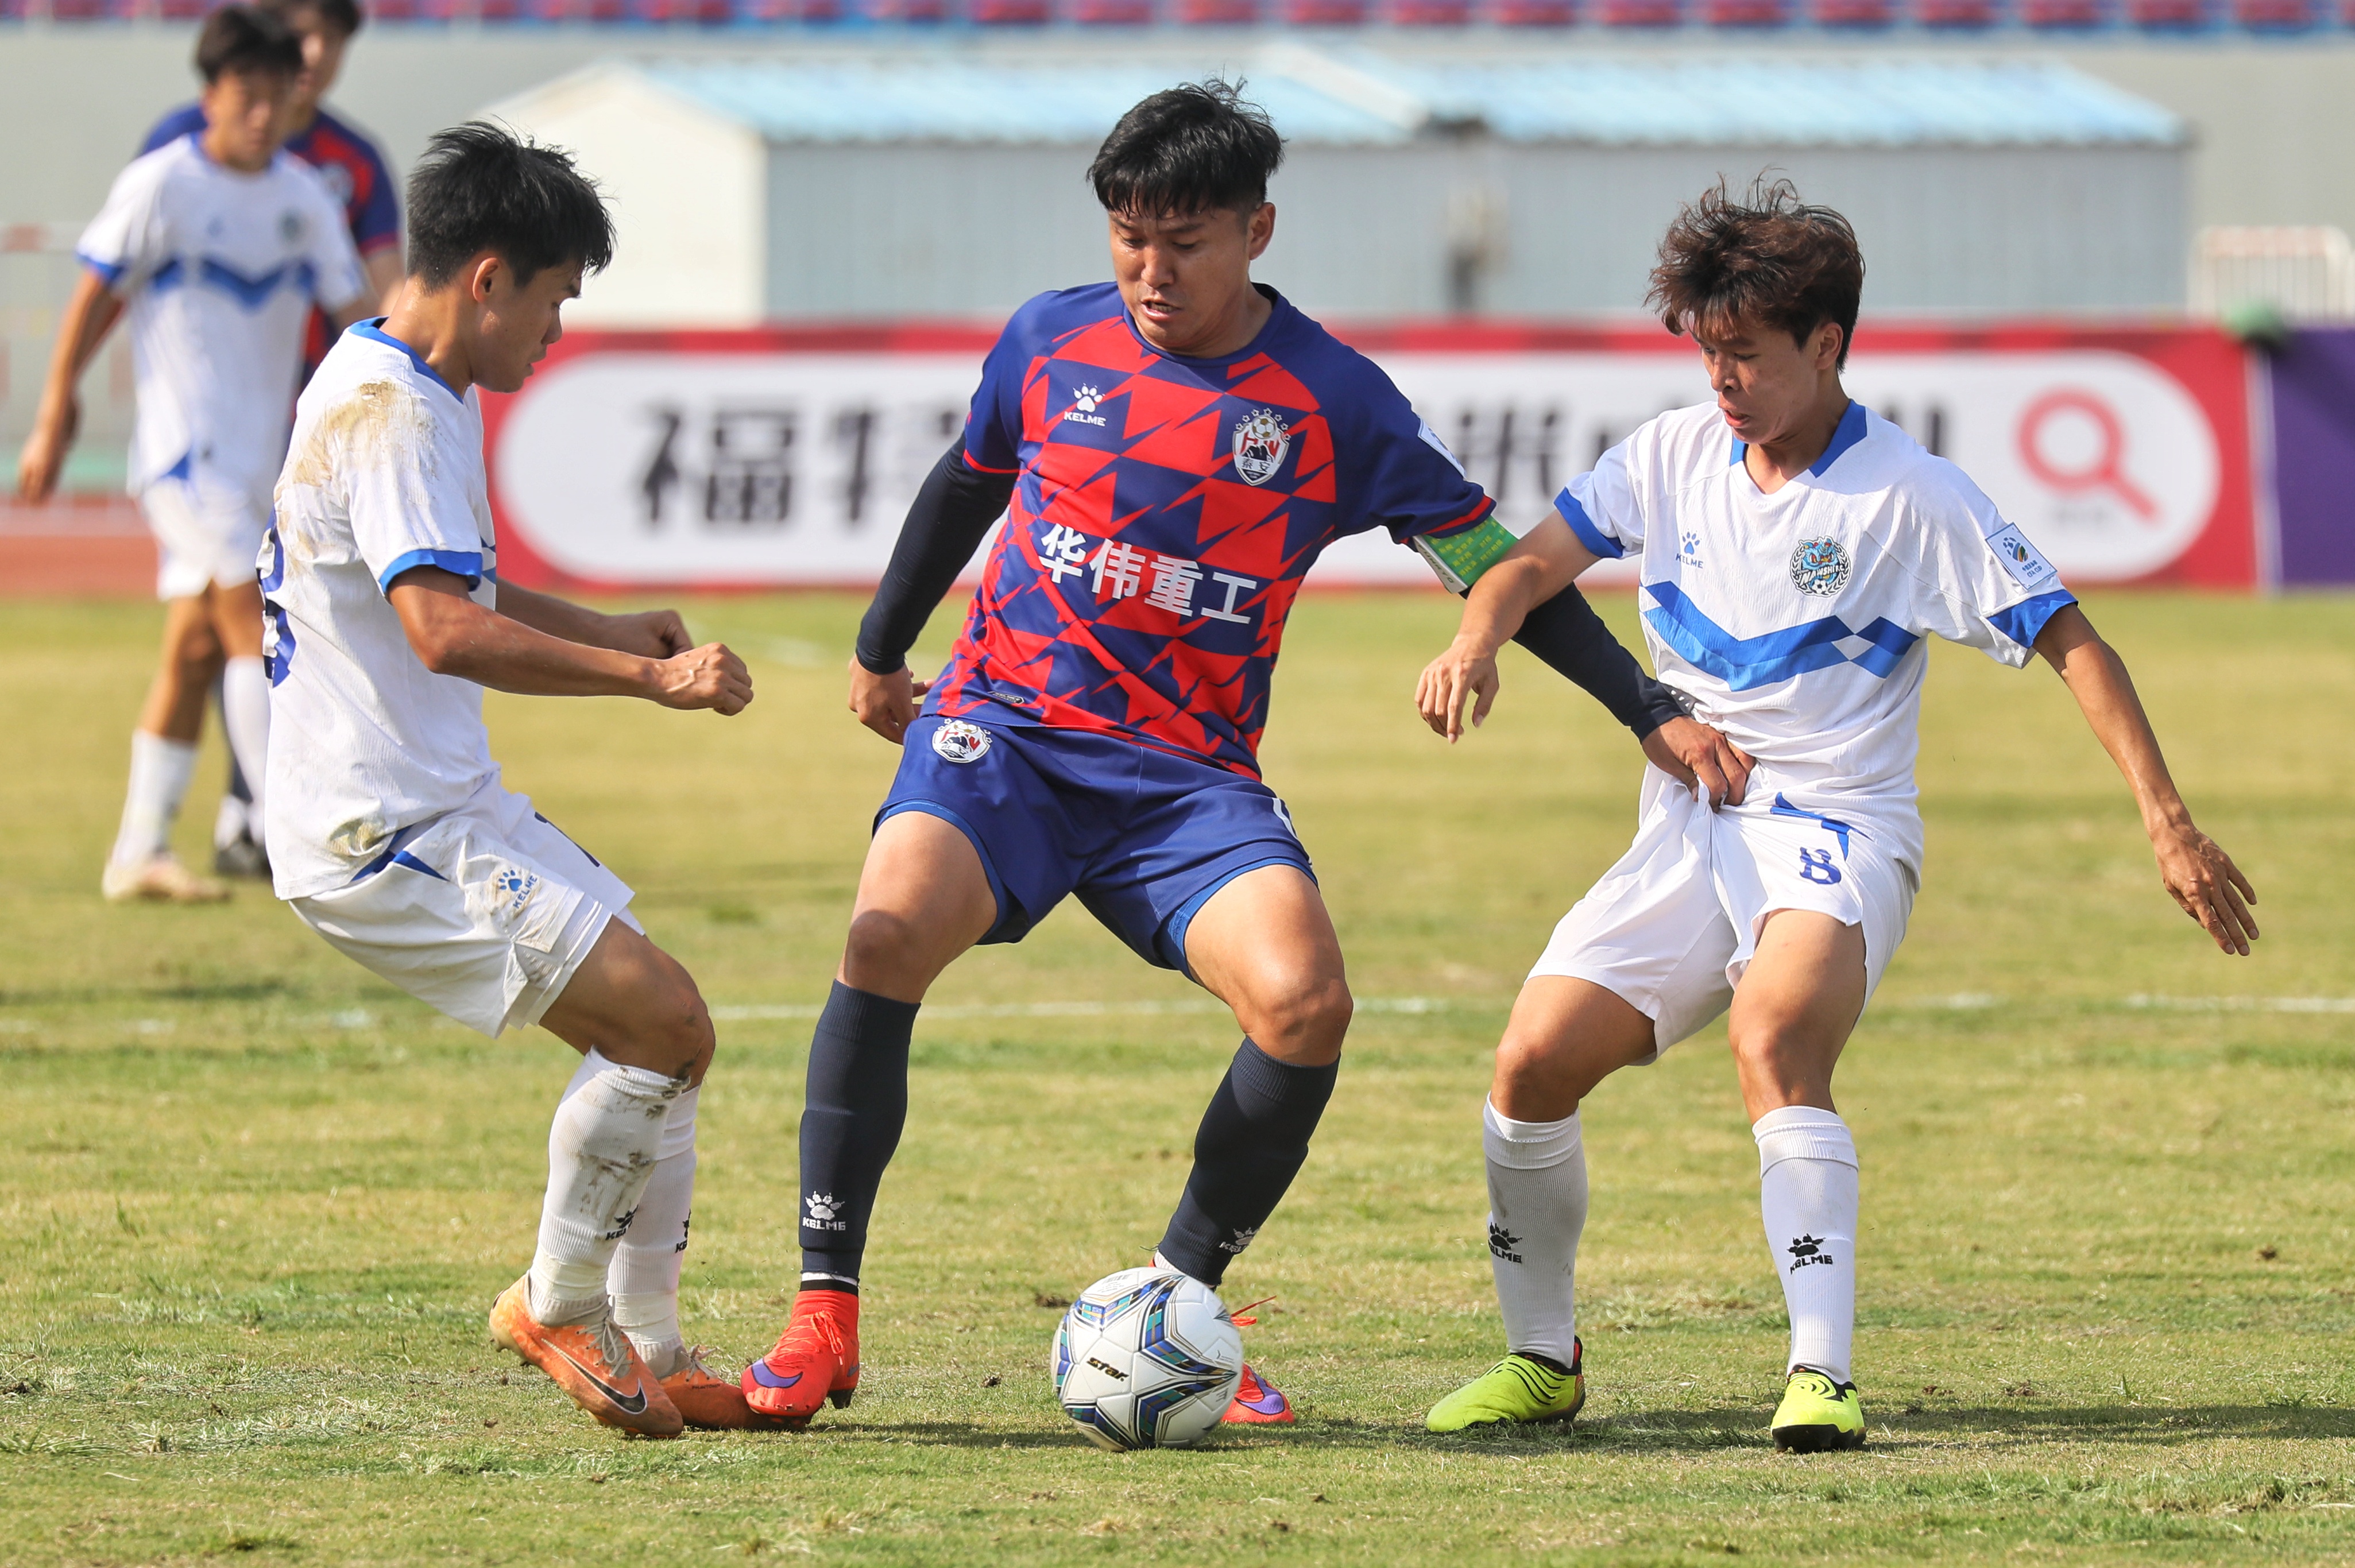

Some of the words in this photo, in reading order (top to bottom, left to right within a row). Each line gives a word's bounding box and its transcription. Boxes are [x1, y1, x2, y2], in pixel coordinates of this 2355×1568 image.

[1064, 411, 1107, 427] KELME
[1676, 553, 1704, 569] KELME
[2034, 565, 2043, 573] CUP
[1038, 522, 1257, 624] 华伟重工
[513, 875, 537, 909] KELME
[802, 1217, 846, 1231] KELME
